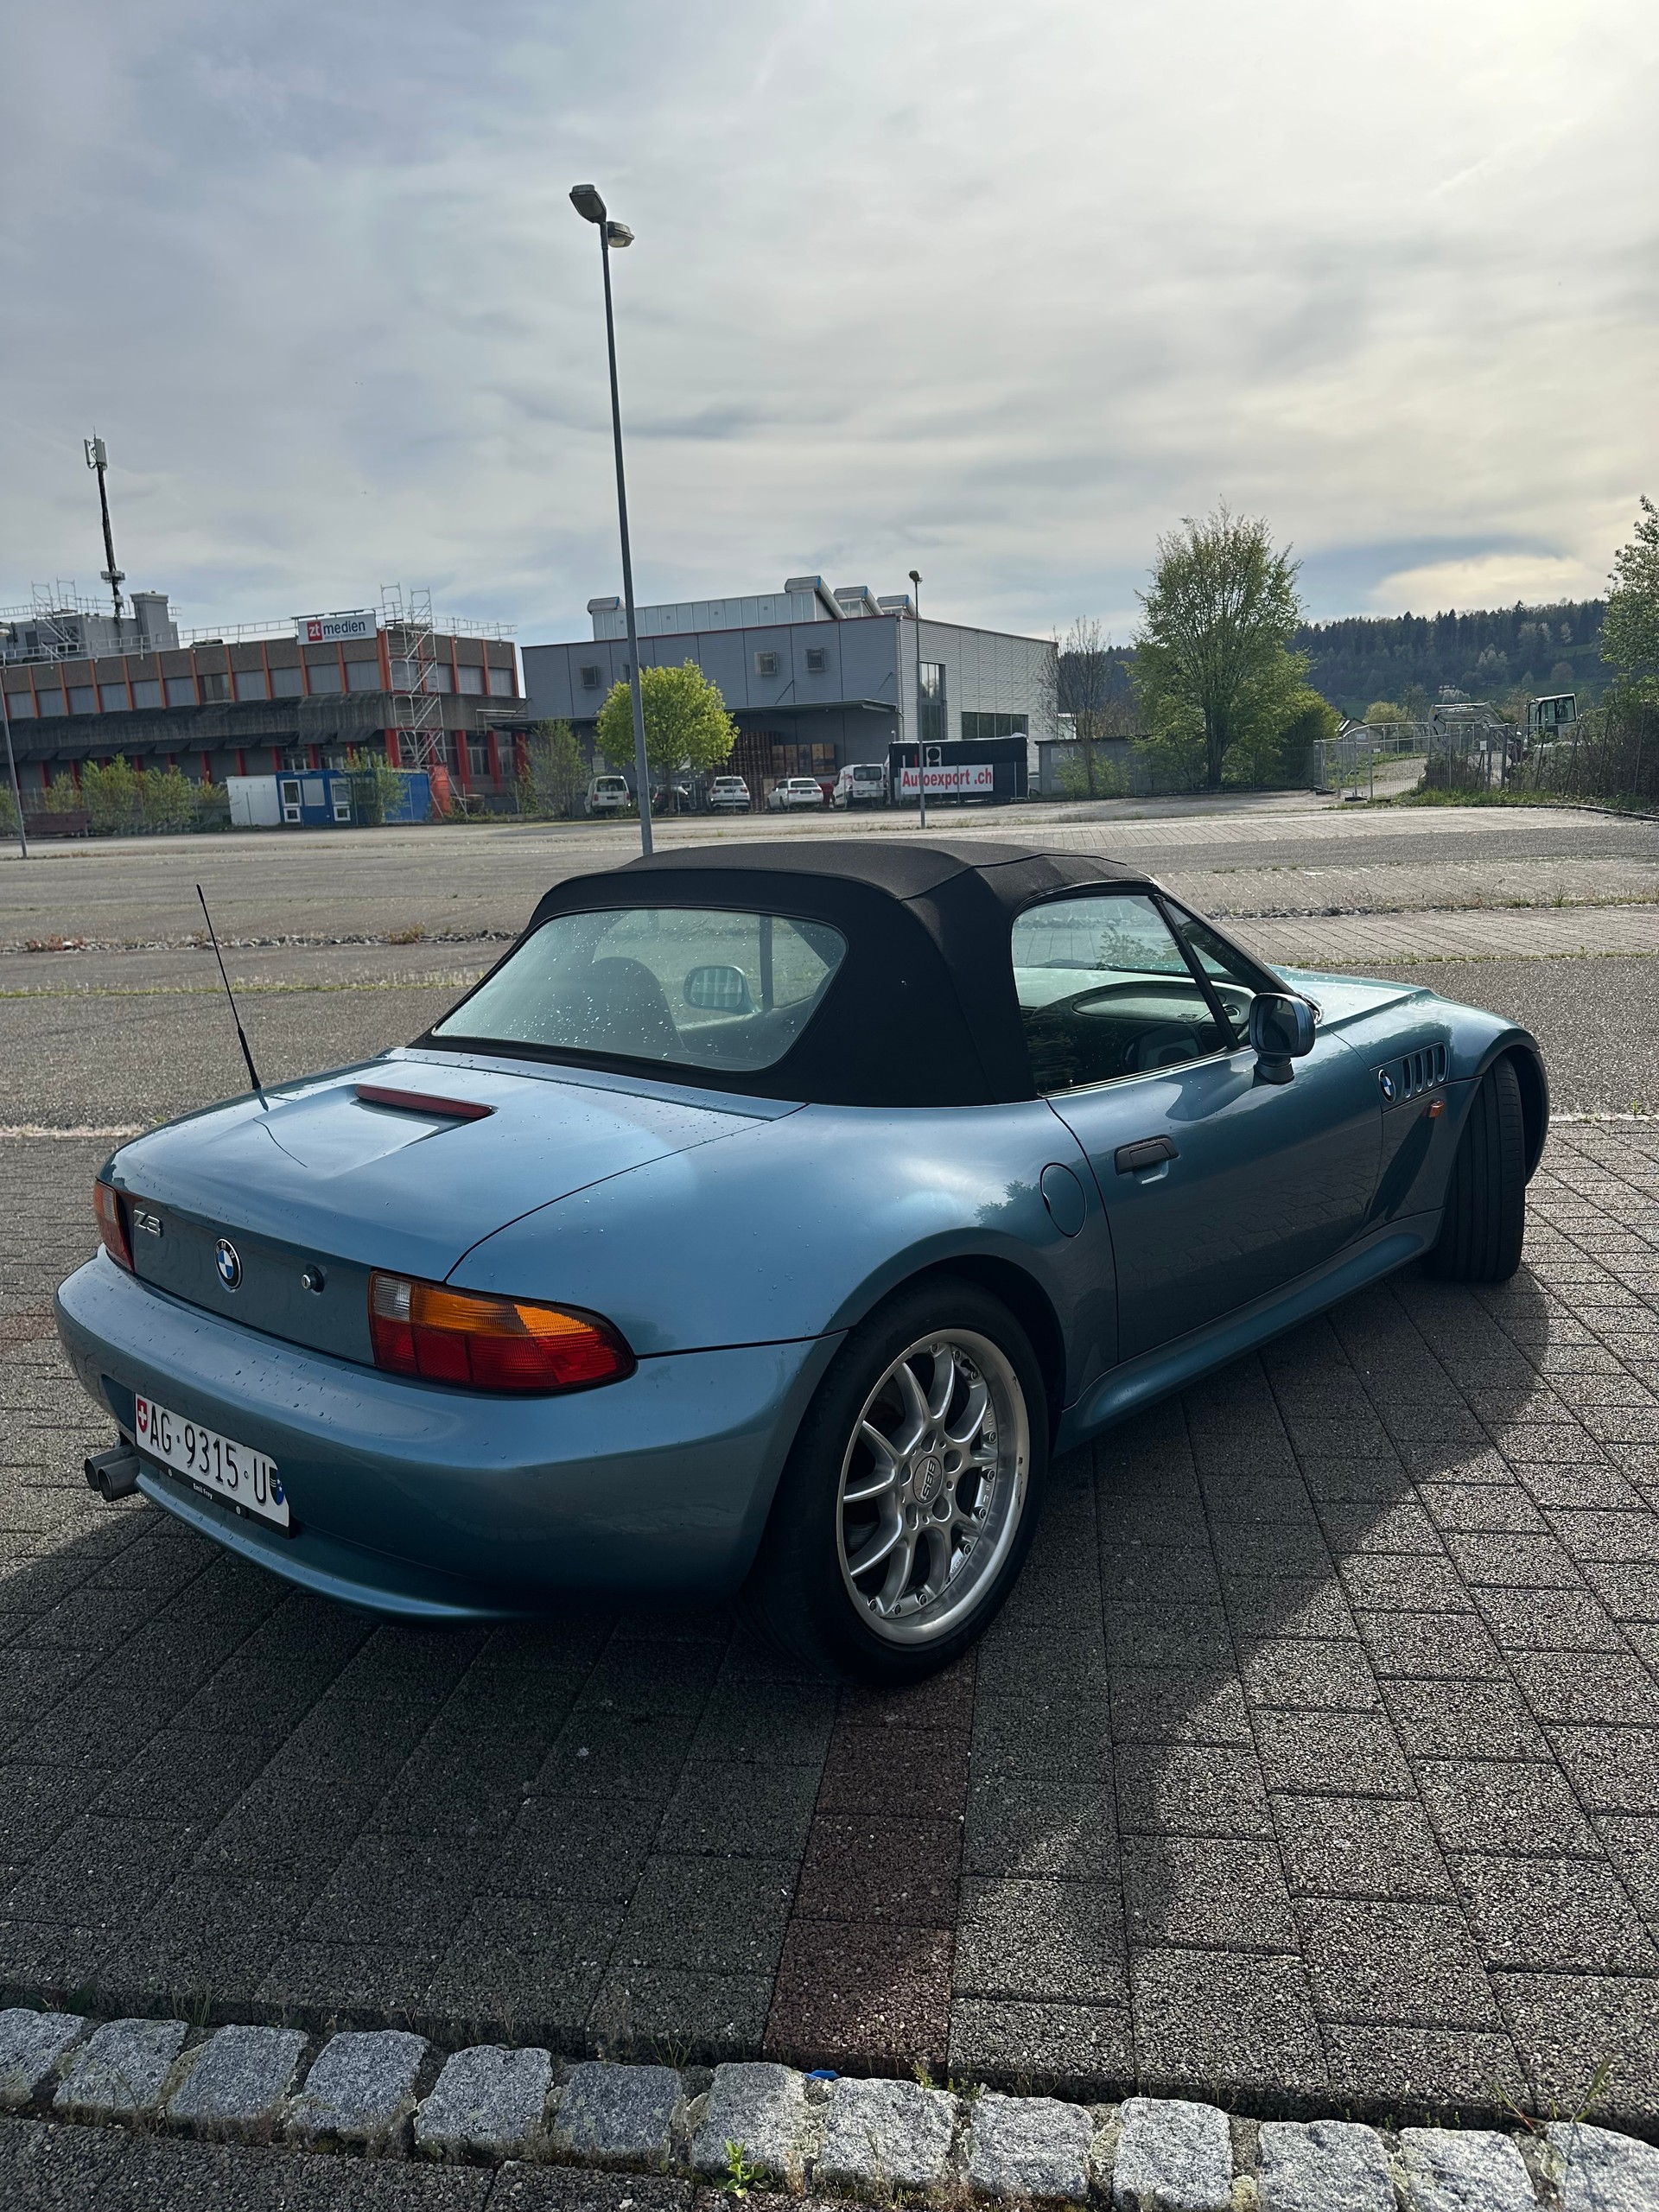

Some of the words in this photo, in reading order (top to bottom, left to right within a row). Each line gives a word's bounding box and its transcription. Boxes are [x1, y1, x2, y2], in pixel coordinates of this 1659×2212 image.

[308, 623, 321, 637] zt
[323, 620, 366, 635] medien
[902, 769, 970, 790] Auoexport
[133, 1209, 162, 1237] Z3
[921, 1459, 936, 1499] BBS
